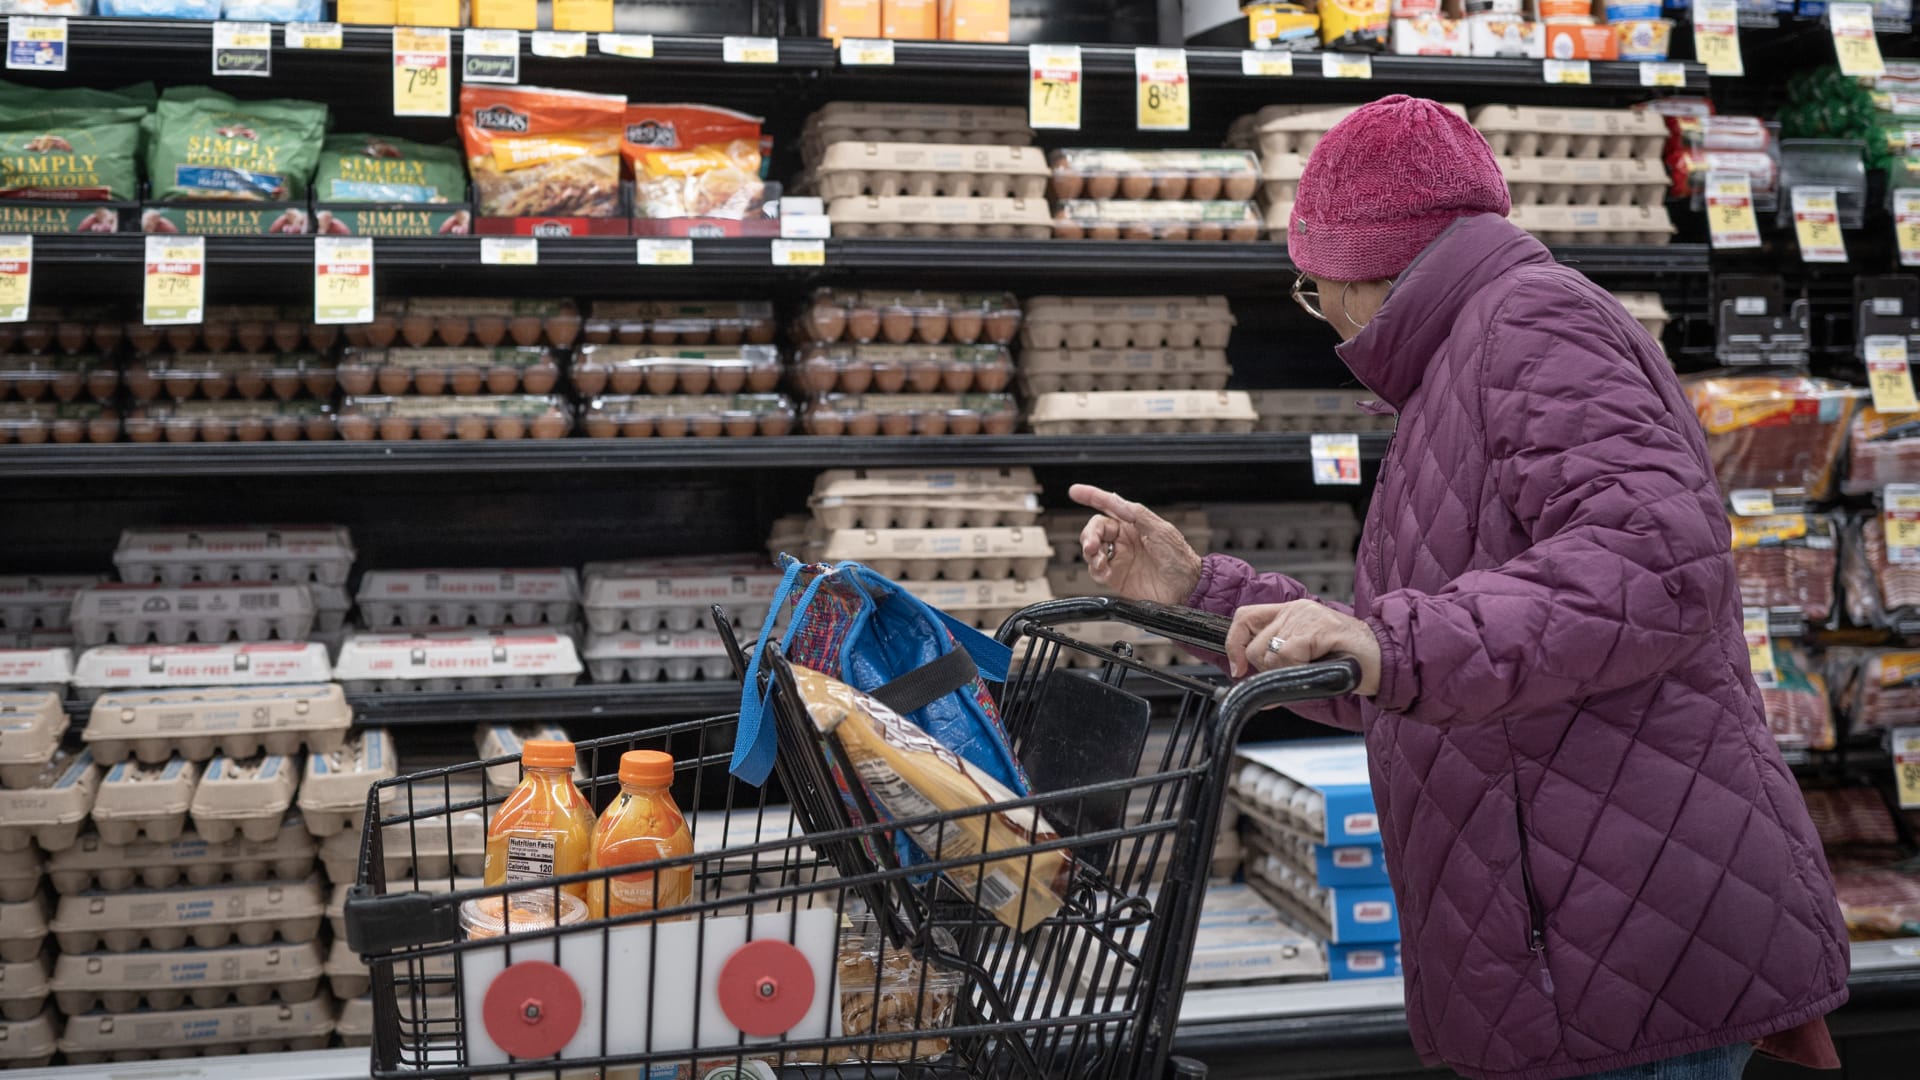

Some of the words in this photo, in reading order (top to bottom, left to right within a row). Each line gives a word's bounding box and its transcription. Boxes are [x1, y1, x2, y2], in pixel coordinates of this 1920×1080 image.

[405, 68, 438, 93] 799
[188, 135, 280, 161] SIMPLY
[2, 154, 98, 174] SIMPLY
[187, 151, 277, 174] POTATOES
[339, 158, 426, 175] SIMPLY
[5, 174, 100, 188] POTATOES
[341, 170, 426, 186] POTATOES
[0, 208, 71, 223] IMPLY
[186, 209, 263, 226] SIMPLY
[357, 211, 433, 226] SIMPLY
[510, 839, 537, 848] Nutrition
[537, 841, 554, 849] Facts
[508, 862, 530, 871] Calories
[539, 864, 552, 873] 120
[614, 888, 652, 897] STRAIGH
